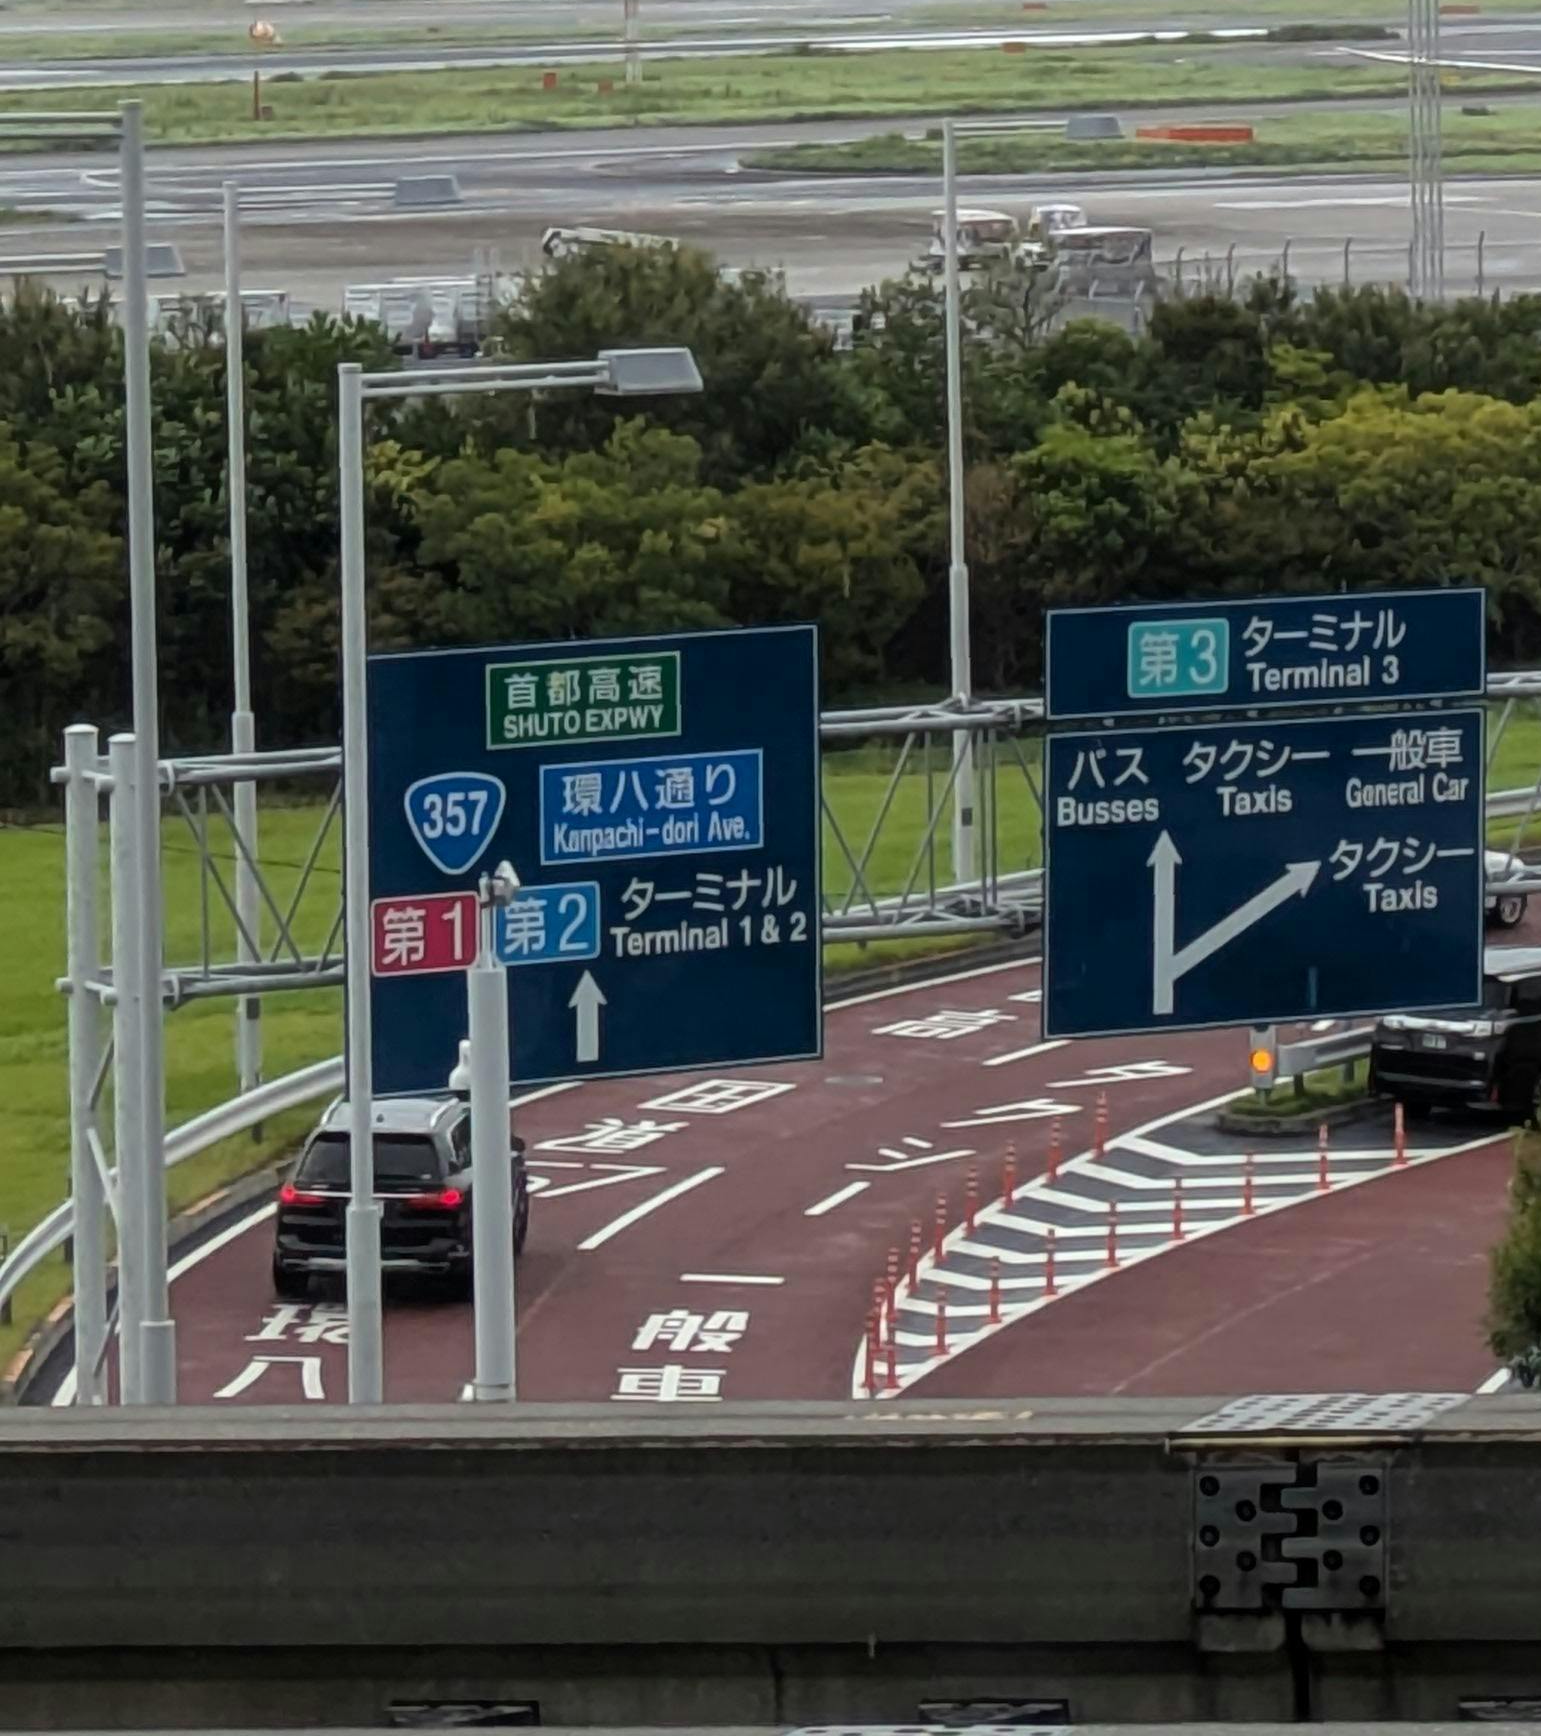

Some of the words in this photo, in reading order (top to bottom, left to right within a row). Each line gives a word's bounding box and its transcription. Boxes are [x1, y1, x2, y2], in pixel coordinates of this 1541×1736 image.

[1242, 608, 1406, 658] ターミナル
[503, 665, 663, 710] 首都高速
[1245, 655, 1370, 692] Terminal
[1382, 654, 1400, 685] 3
[503, 710, 580, 739] SHUTO
[584, 704, 665, 733] EXPWY
[1067, 747, 1150, 791] バス
[1182, 738, 1330, 784] タクシー
[1351, 726, 1464, 772] 一般車
[562, 763, 737, 817] 環八通り
[1057, 795, 1159, 826] Busses
[1216, 783, 1293, 816] Taxis
[1345, 778, 1424, 808] General
[1432, 772, 1469, 803] Car
[422, 790, 489, 839] 357
[553, 813, 699, 856] Kanpachi-dori
[707, 811, 751, 842] Ave.
[1329, 836, 1475, 881] タクシー
[620, 865, 797, 921] ターミナル
[1362, 879, 1438, 913] Taxis
[610, 919, 728, 958] Terminal
[739, 917, 752, 947] 1
[760, 915, 780, 944] &
[789, 911, 808, 942] 2
